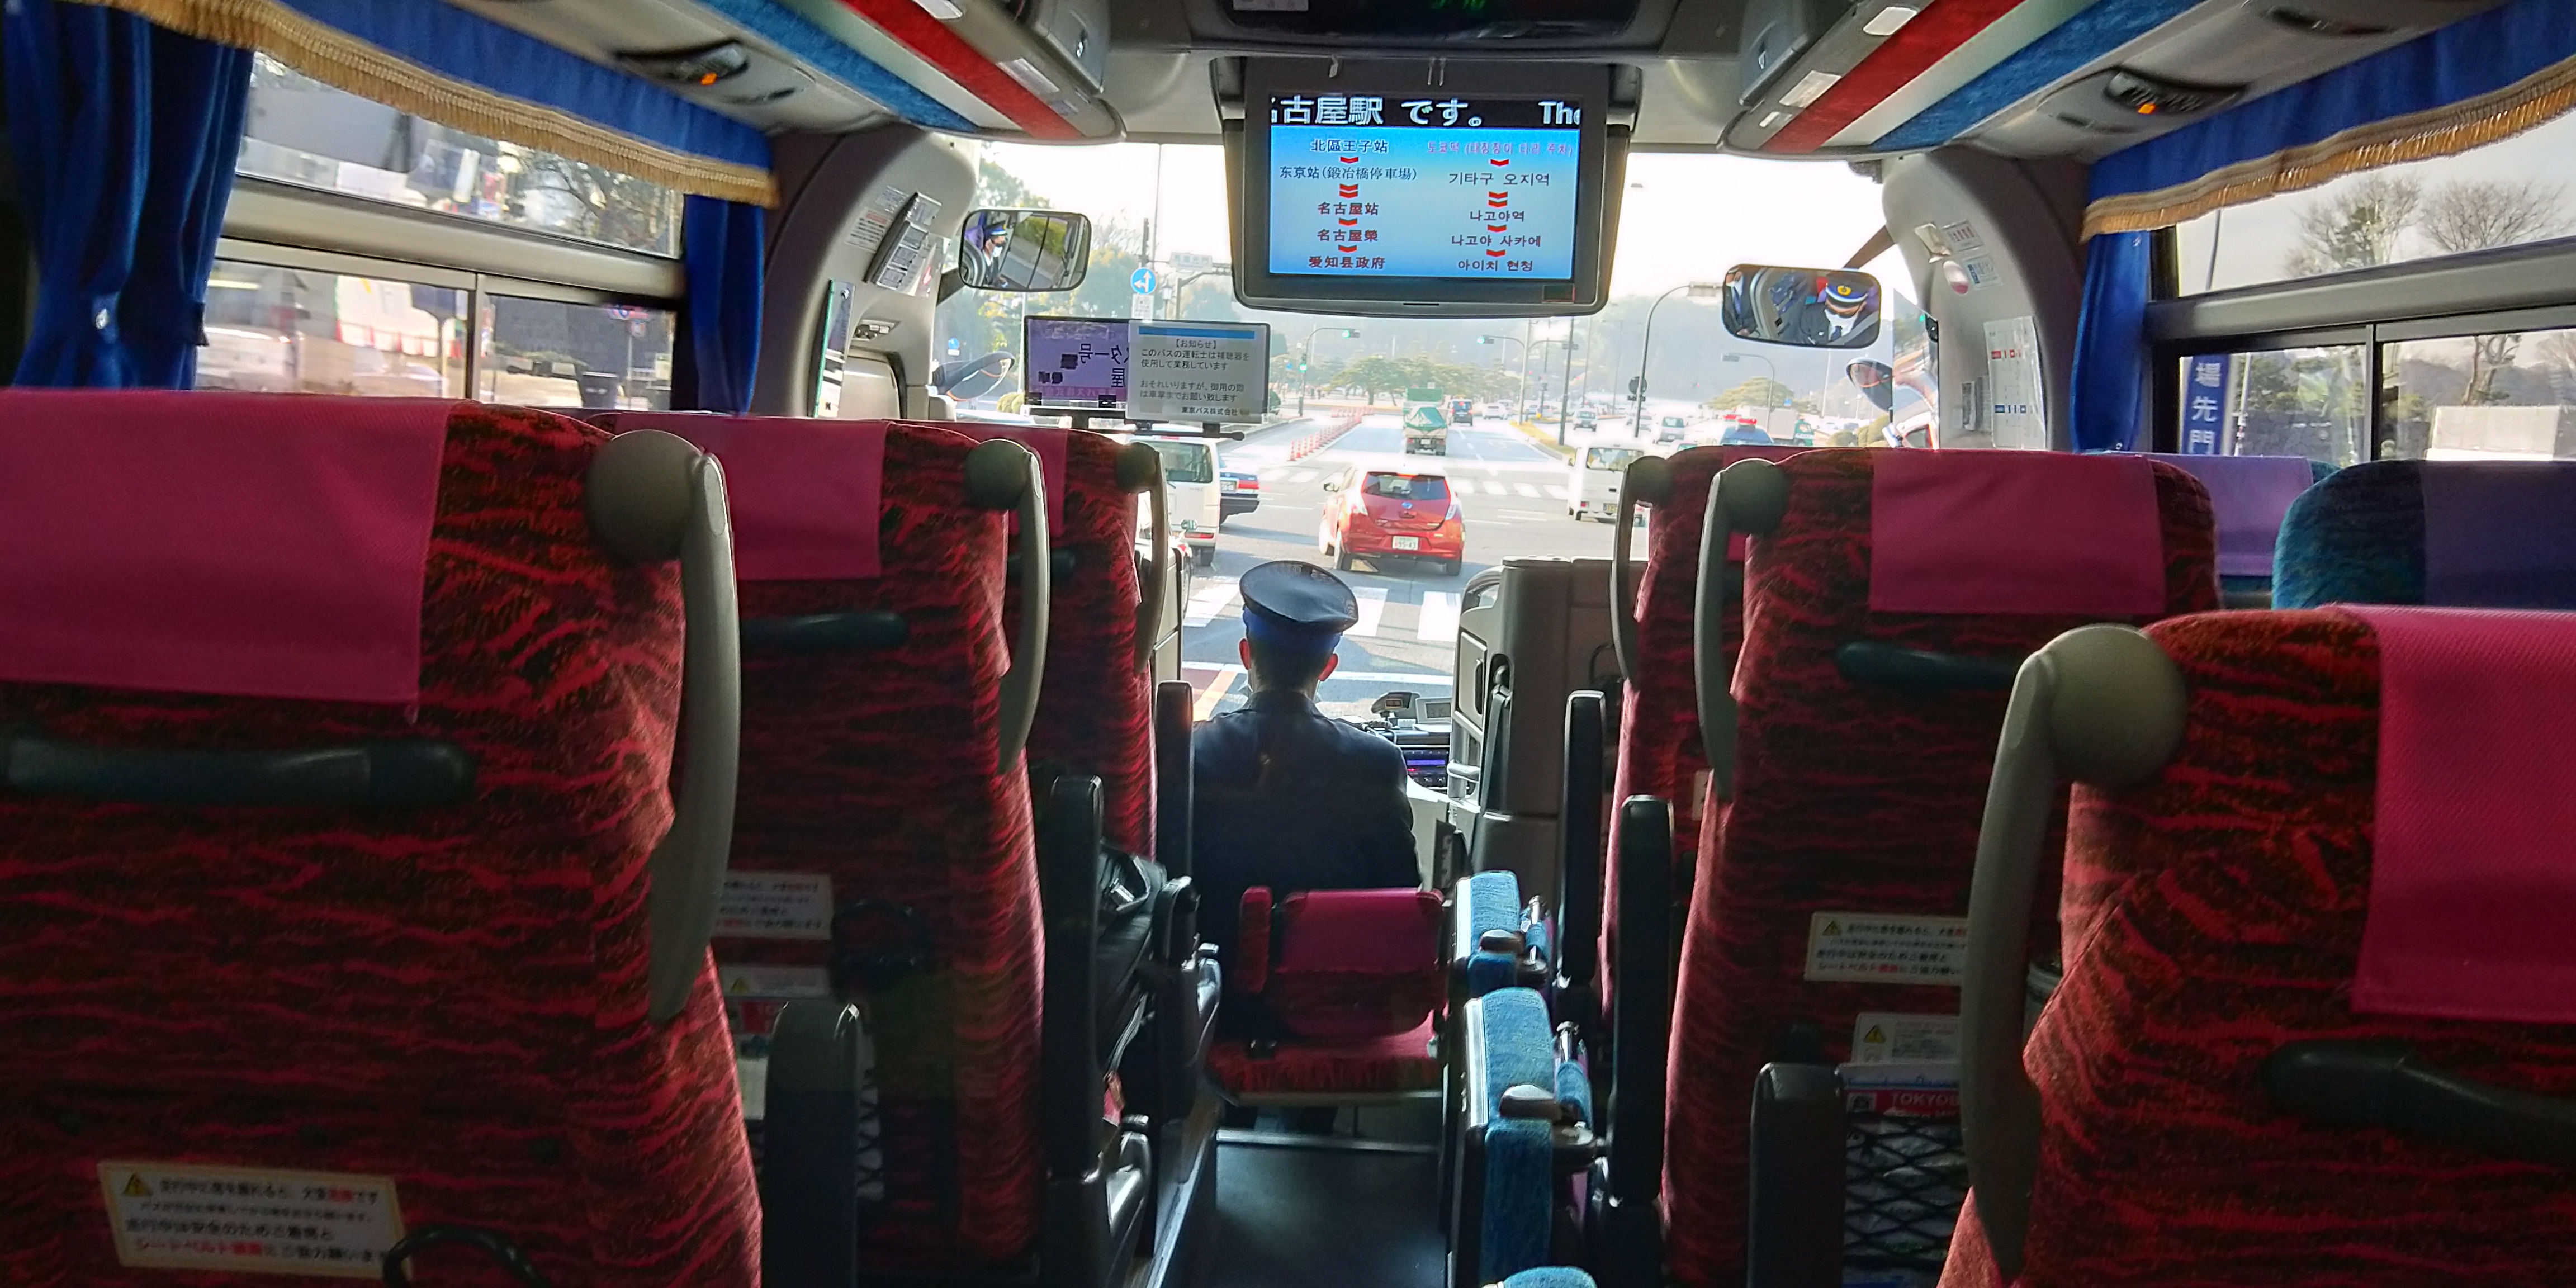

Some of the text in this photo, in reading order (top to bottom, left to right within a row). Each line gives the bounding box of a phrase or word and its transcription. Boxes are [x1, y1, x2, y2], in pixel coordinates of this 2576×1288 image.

[1271, 94, 1483, 127] 古屋駅 です。
[1310, 140, 1389, 153] 北區王子站
[1448, 172, 1550, 186] 기타구 오지역
[1317, 202, 1379, 216] 名古屋站
[1470, 210, 1525, 222] 나고야역
[1317, 229, 1379, 243] 名古屋榮
[1451, 235, 1541, 247] 나고야 사카에
[1458, 259, 1498, 271] 아이치
[1175, 339, 1217, 349] 【お知らせ】
[1141, 359, 1229, 371] 使用して業務しています
[1181, 406, 1238, 416] 東京バス株式会社
[2188, 362, 2222, 454] 場先門
